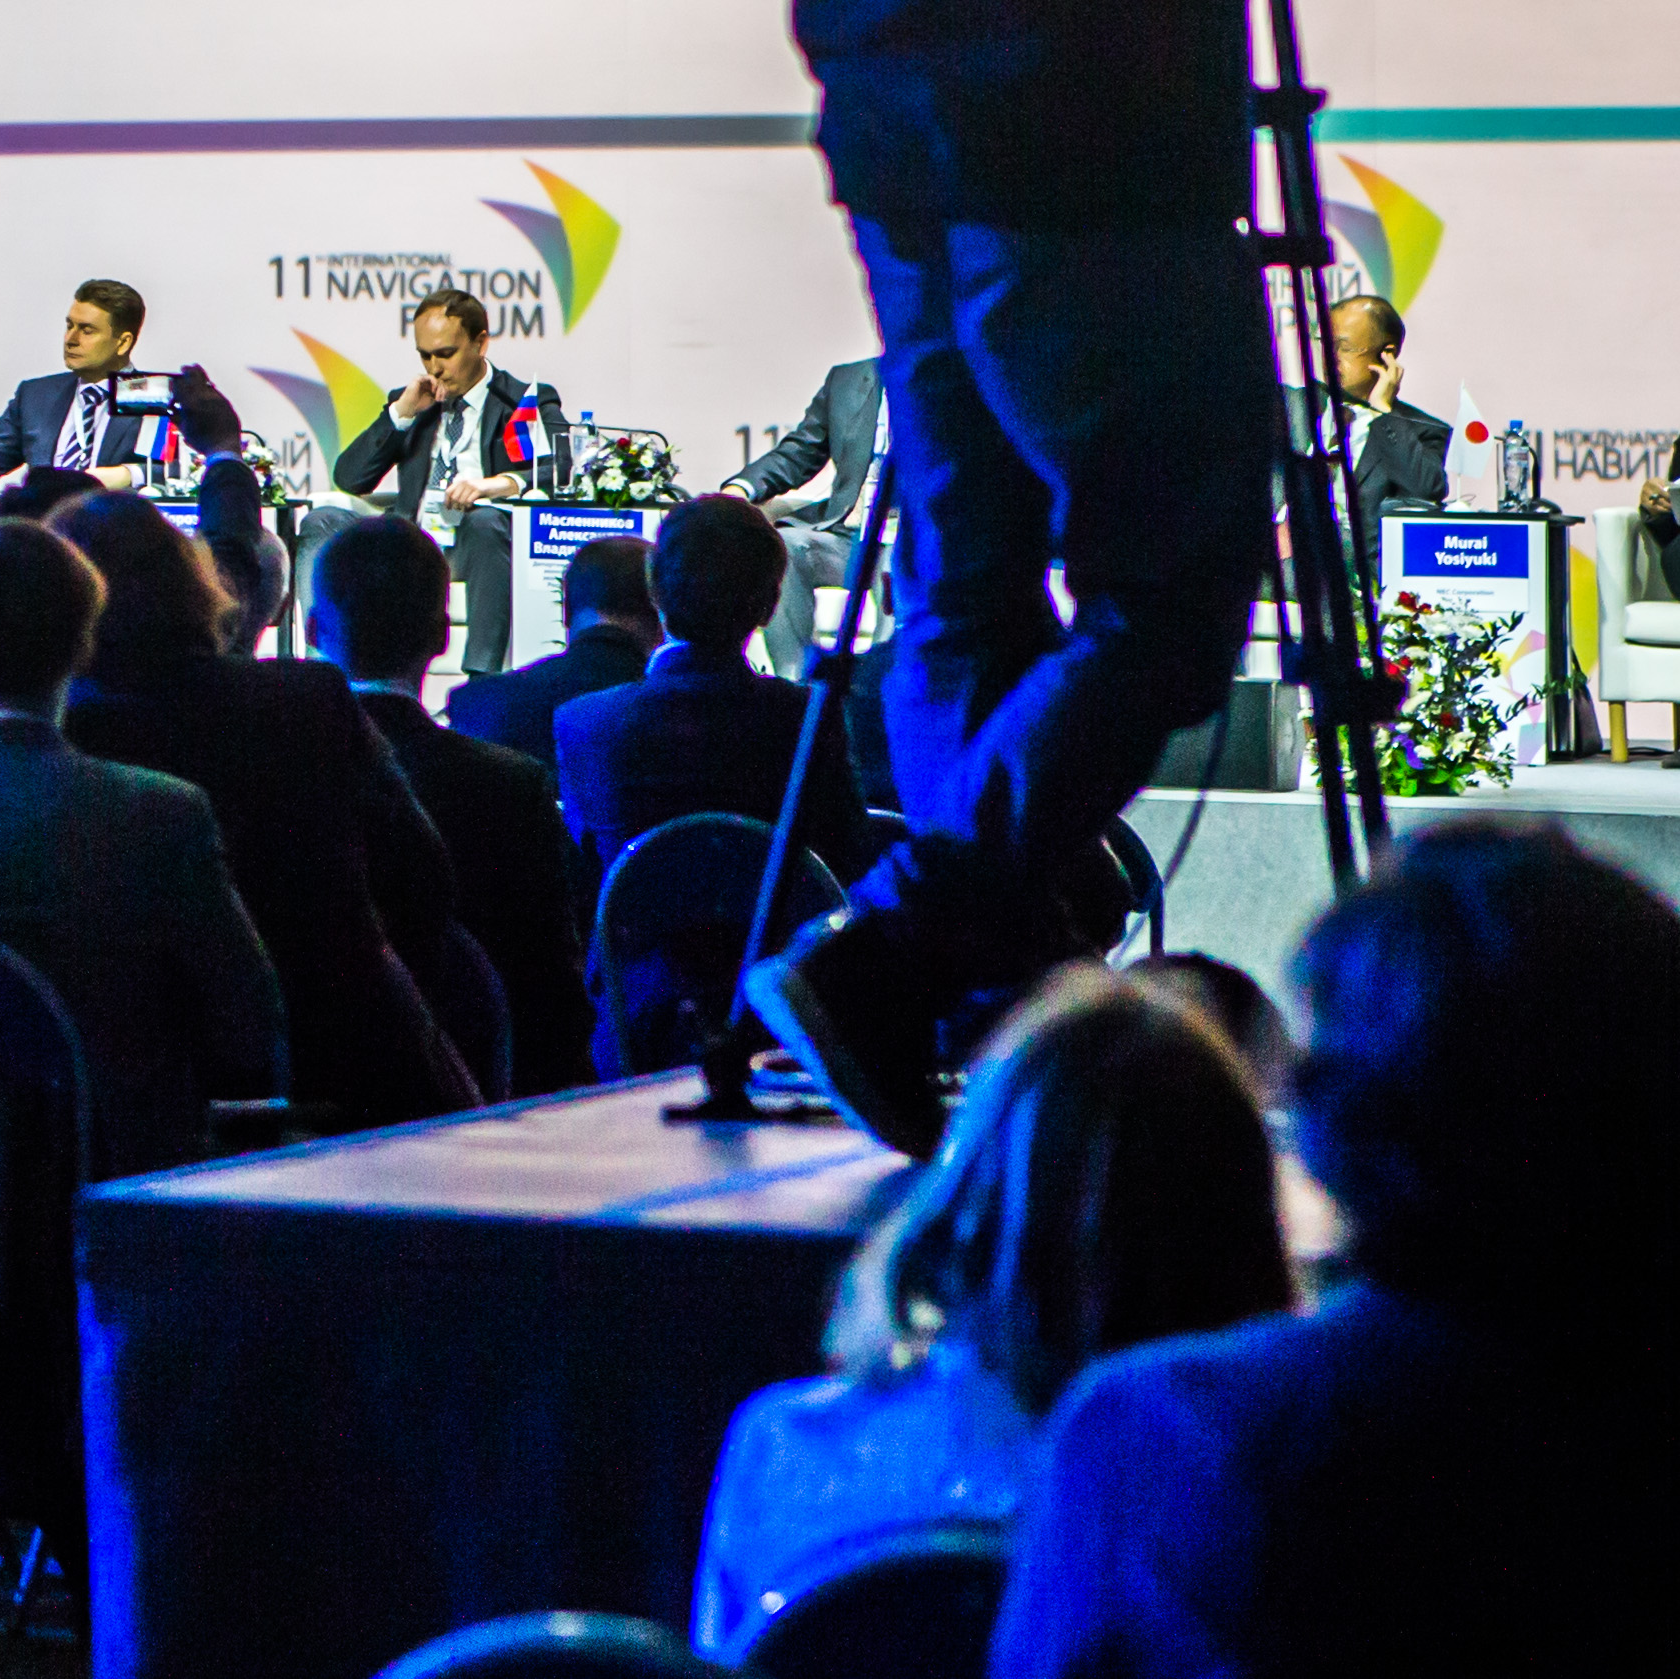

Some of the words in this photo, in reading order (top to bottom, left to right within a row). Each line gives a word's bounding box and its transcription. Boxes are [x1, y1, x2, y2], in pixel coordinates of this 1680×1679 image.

[327, 268, 542, 301] NAVIGATION
[539, 512, 635, 530] Масленников
[1444, 535, 1488, 550] Murai
[1434, 551, 1498, 569] Yosiyuki
